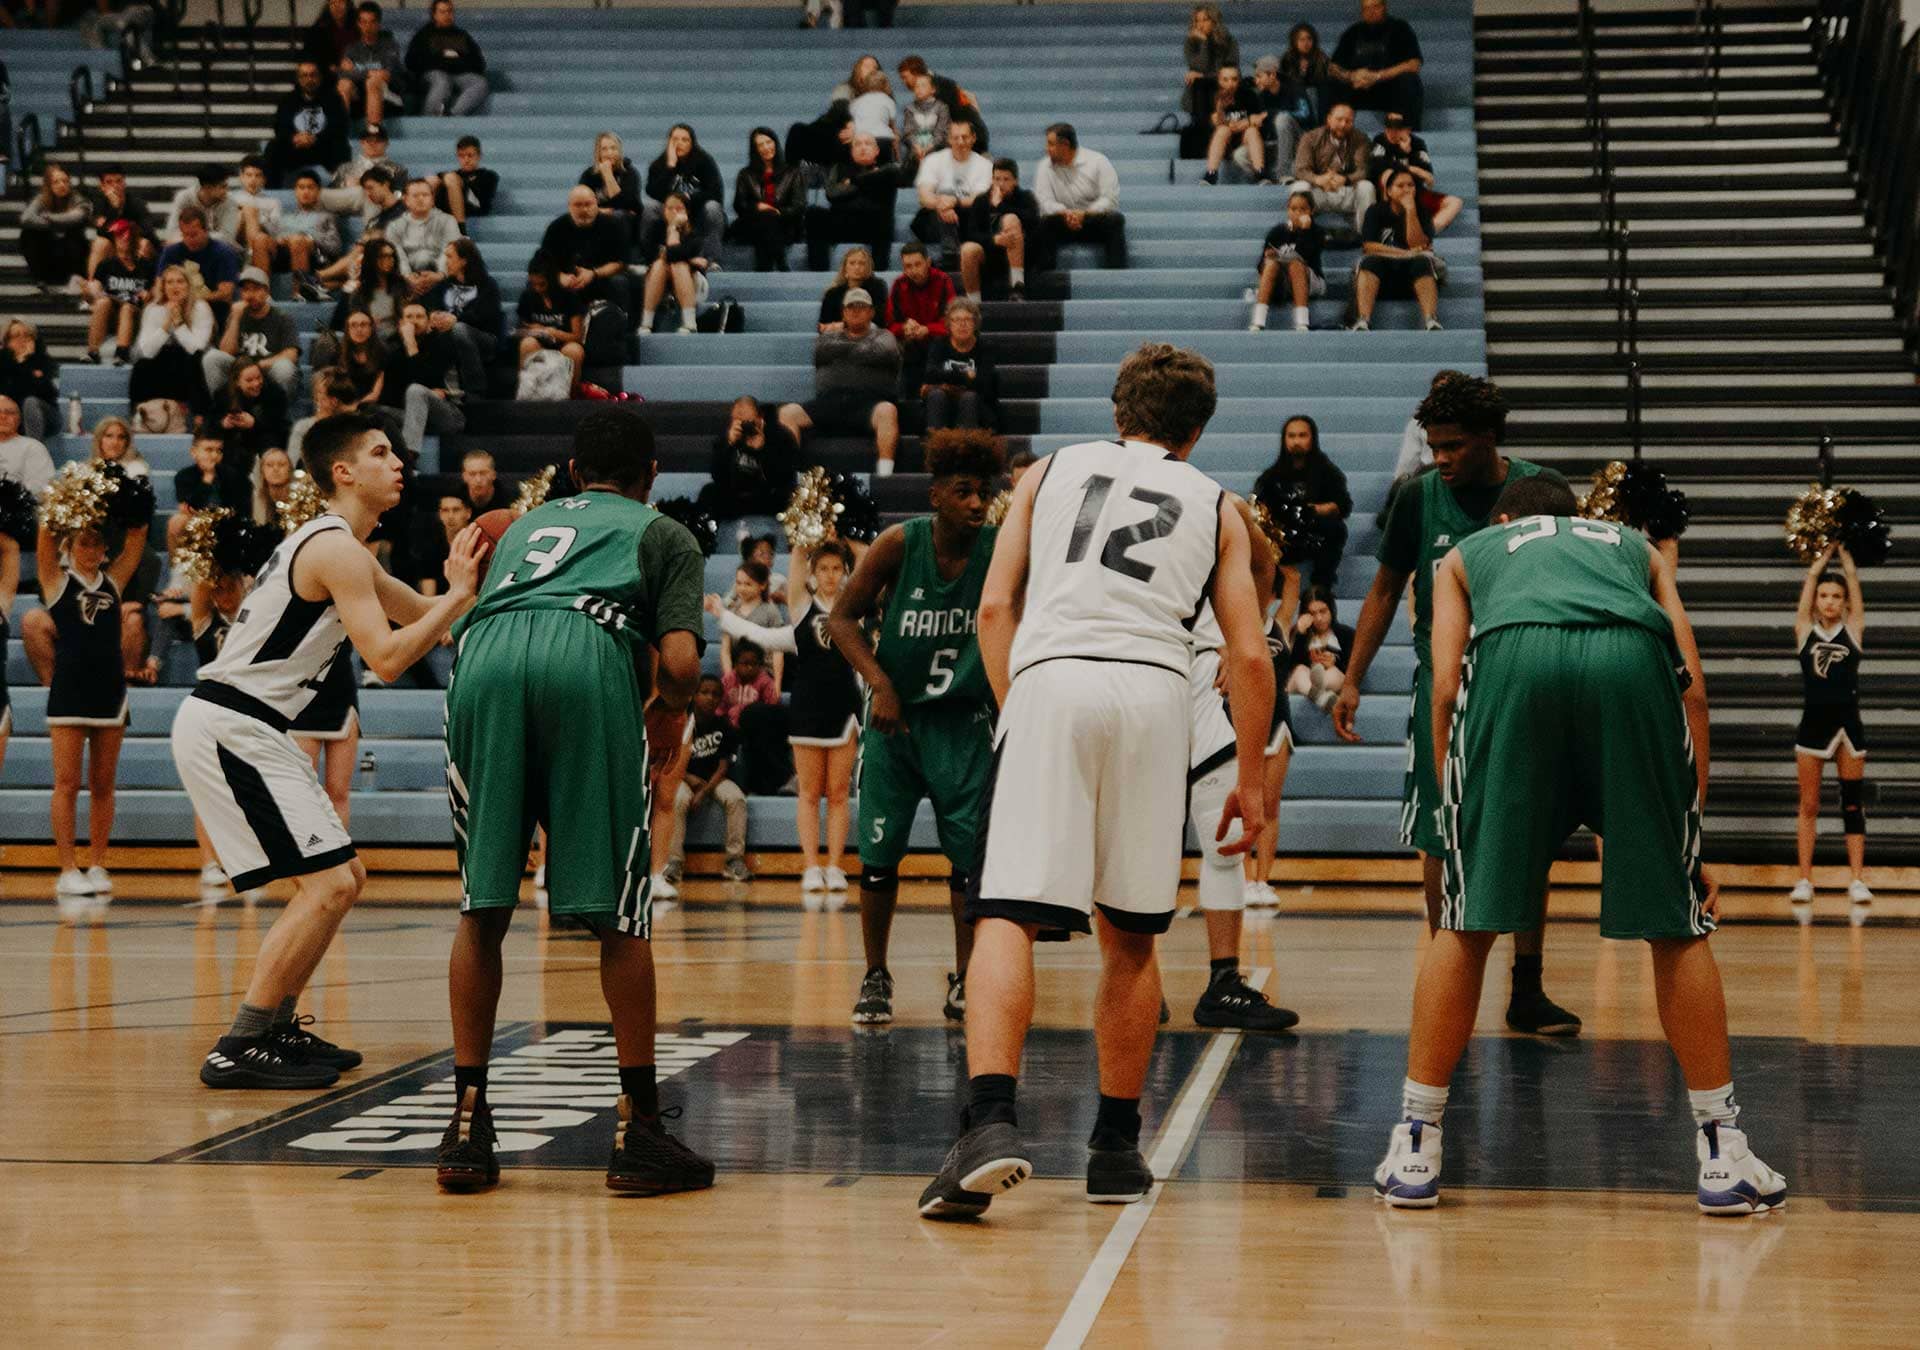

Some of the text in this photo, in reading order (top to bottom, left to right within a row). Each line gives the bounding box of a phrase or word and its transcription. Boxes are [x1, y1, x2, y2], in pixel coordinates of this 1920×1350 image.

[496, 526, 578, 590] 3
[1065, 474, 1182, 583] 12
[926, 648, 959, 695] 5
[871, 816, 887, 844] 5
[287, 1029, 751, 1153] SUNRISE
